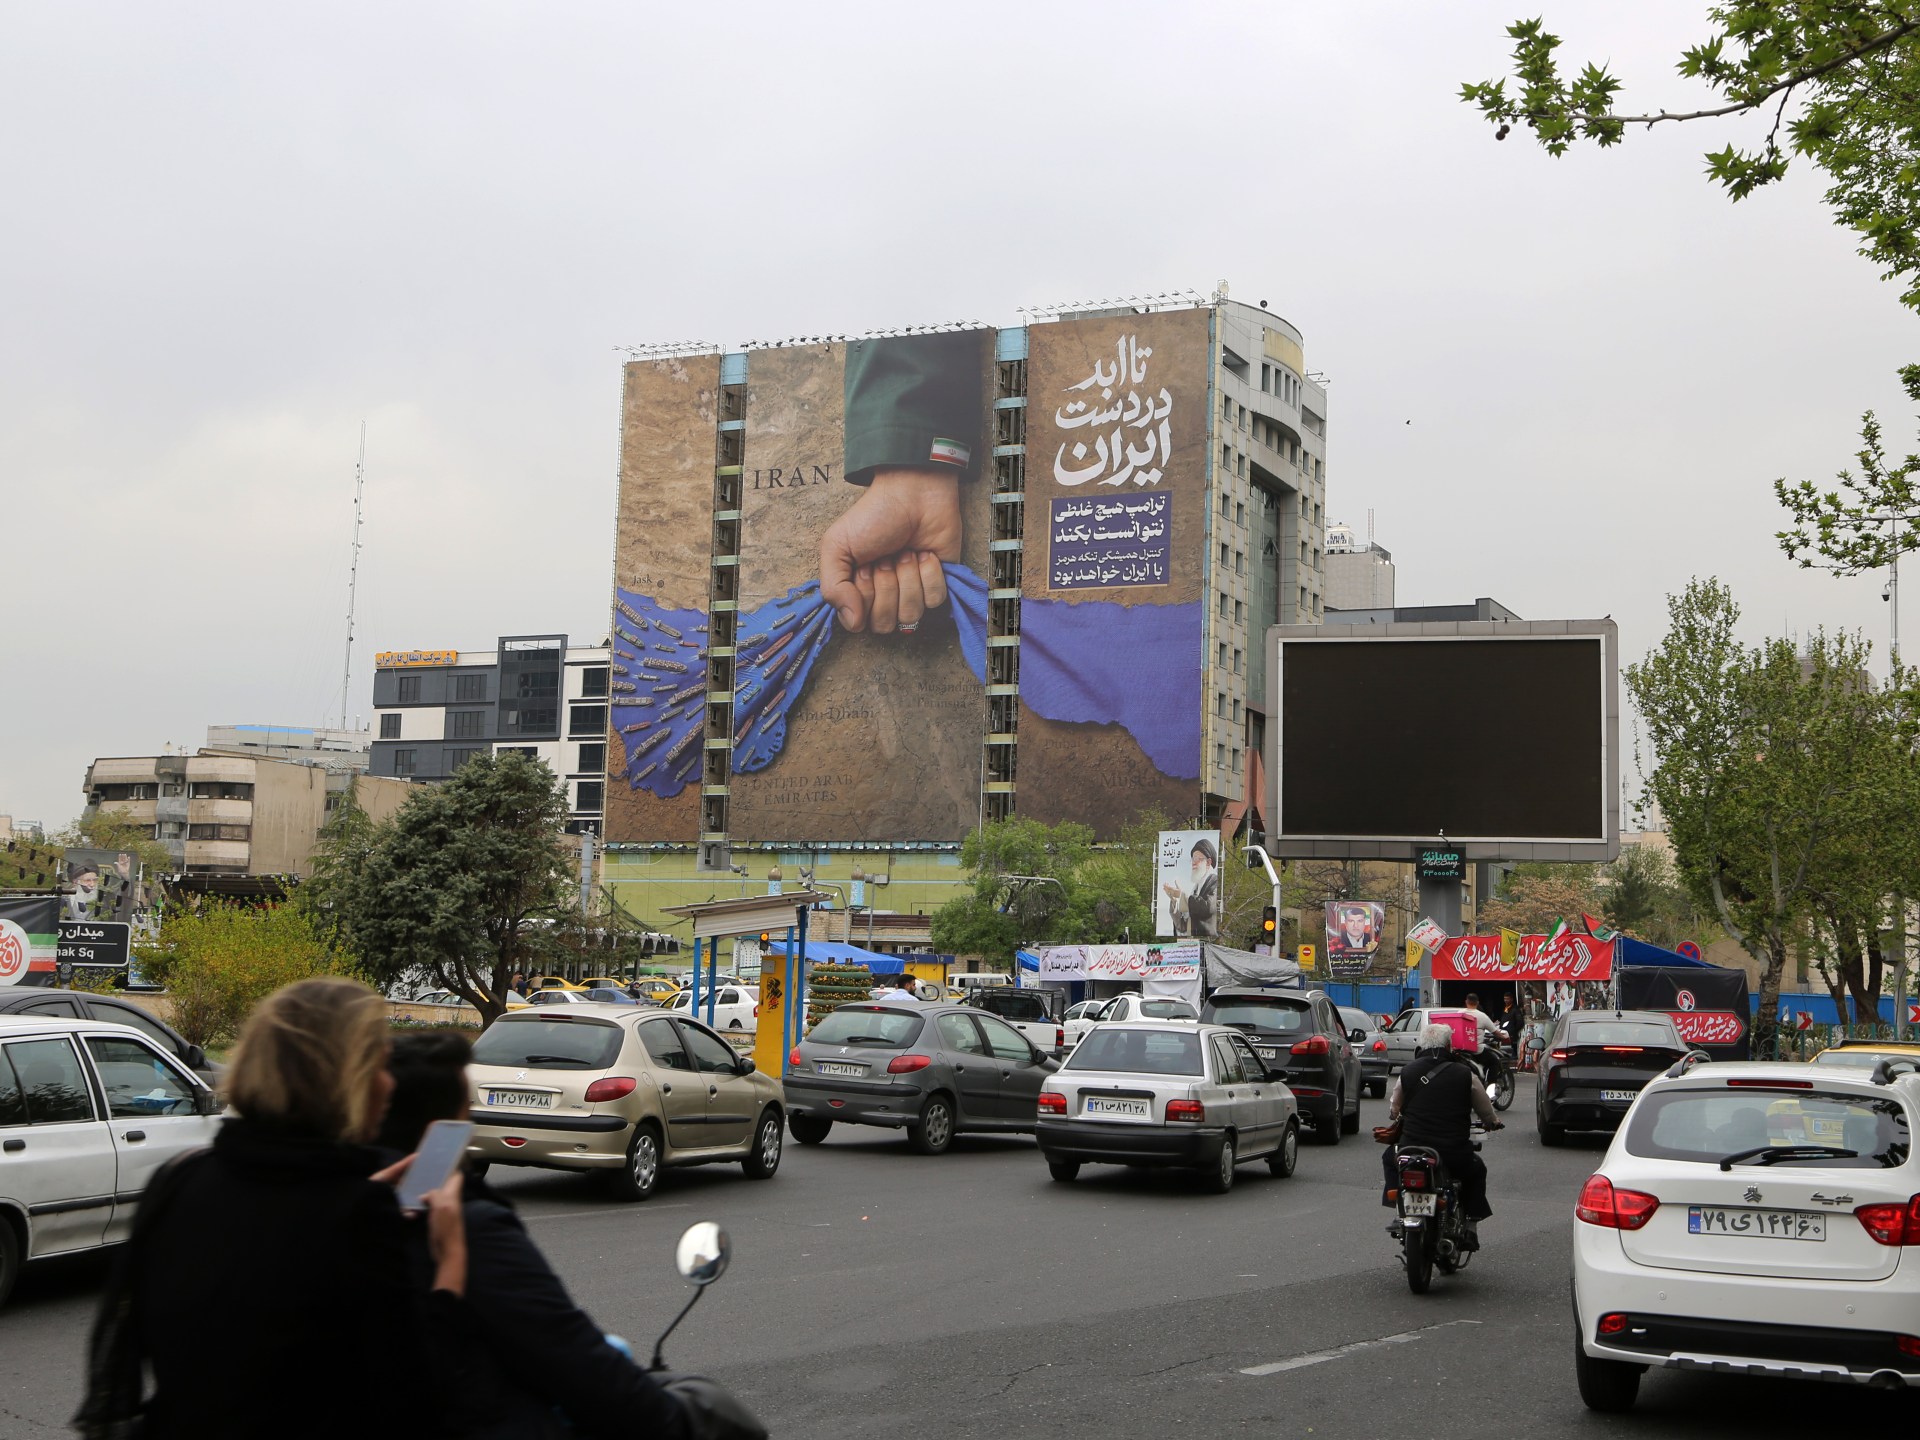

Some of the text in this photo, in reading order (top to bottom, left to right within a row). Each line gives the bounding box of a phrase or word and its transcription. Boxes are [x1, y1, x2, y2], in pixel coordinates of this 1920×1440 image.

[1061, 334, 1153, 401] تا ابد
[1055, 387, 1173, 429] در دست
[1053, 418, 1173, 486] ایران
[753, 464, 831, 490] IRAN
[1054, 495, 1166, 523] ترامپ هیچ غلطی
[1055, 518, 1165, 545] نتوانست بکند
[1055, 553, 1077, 566] هرمز
[1138, 547, 1165, 561] کنترل
[1054, 561, 1164, 586] با ایران خواهد بود
[752, 773, 853, 791] UNITED ARAB
[764, 790, 838, 805] EMIRATES
[1163, 836, 1181, 847] خدای
[1163, 859, 1178, 868] است
[65, 925, 105, 940] میدان
[78, 946, 95, 960] Sq
[1797, 1220, 1822, 1237] ۶۰
